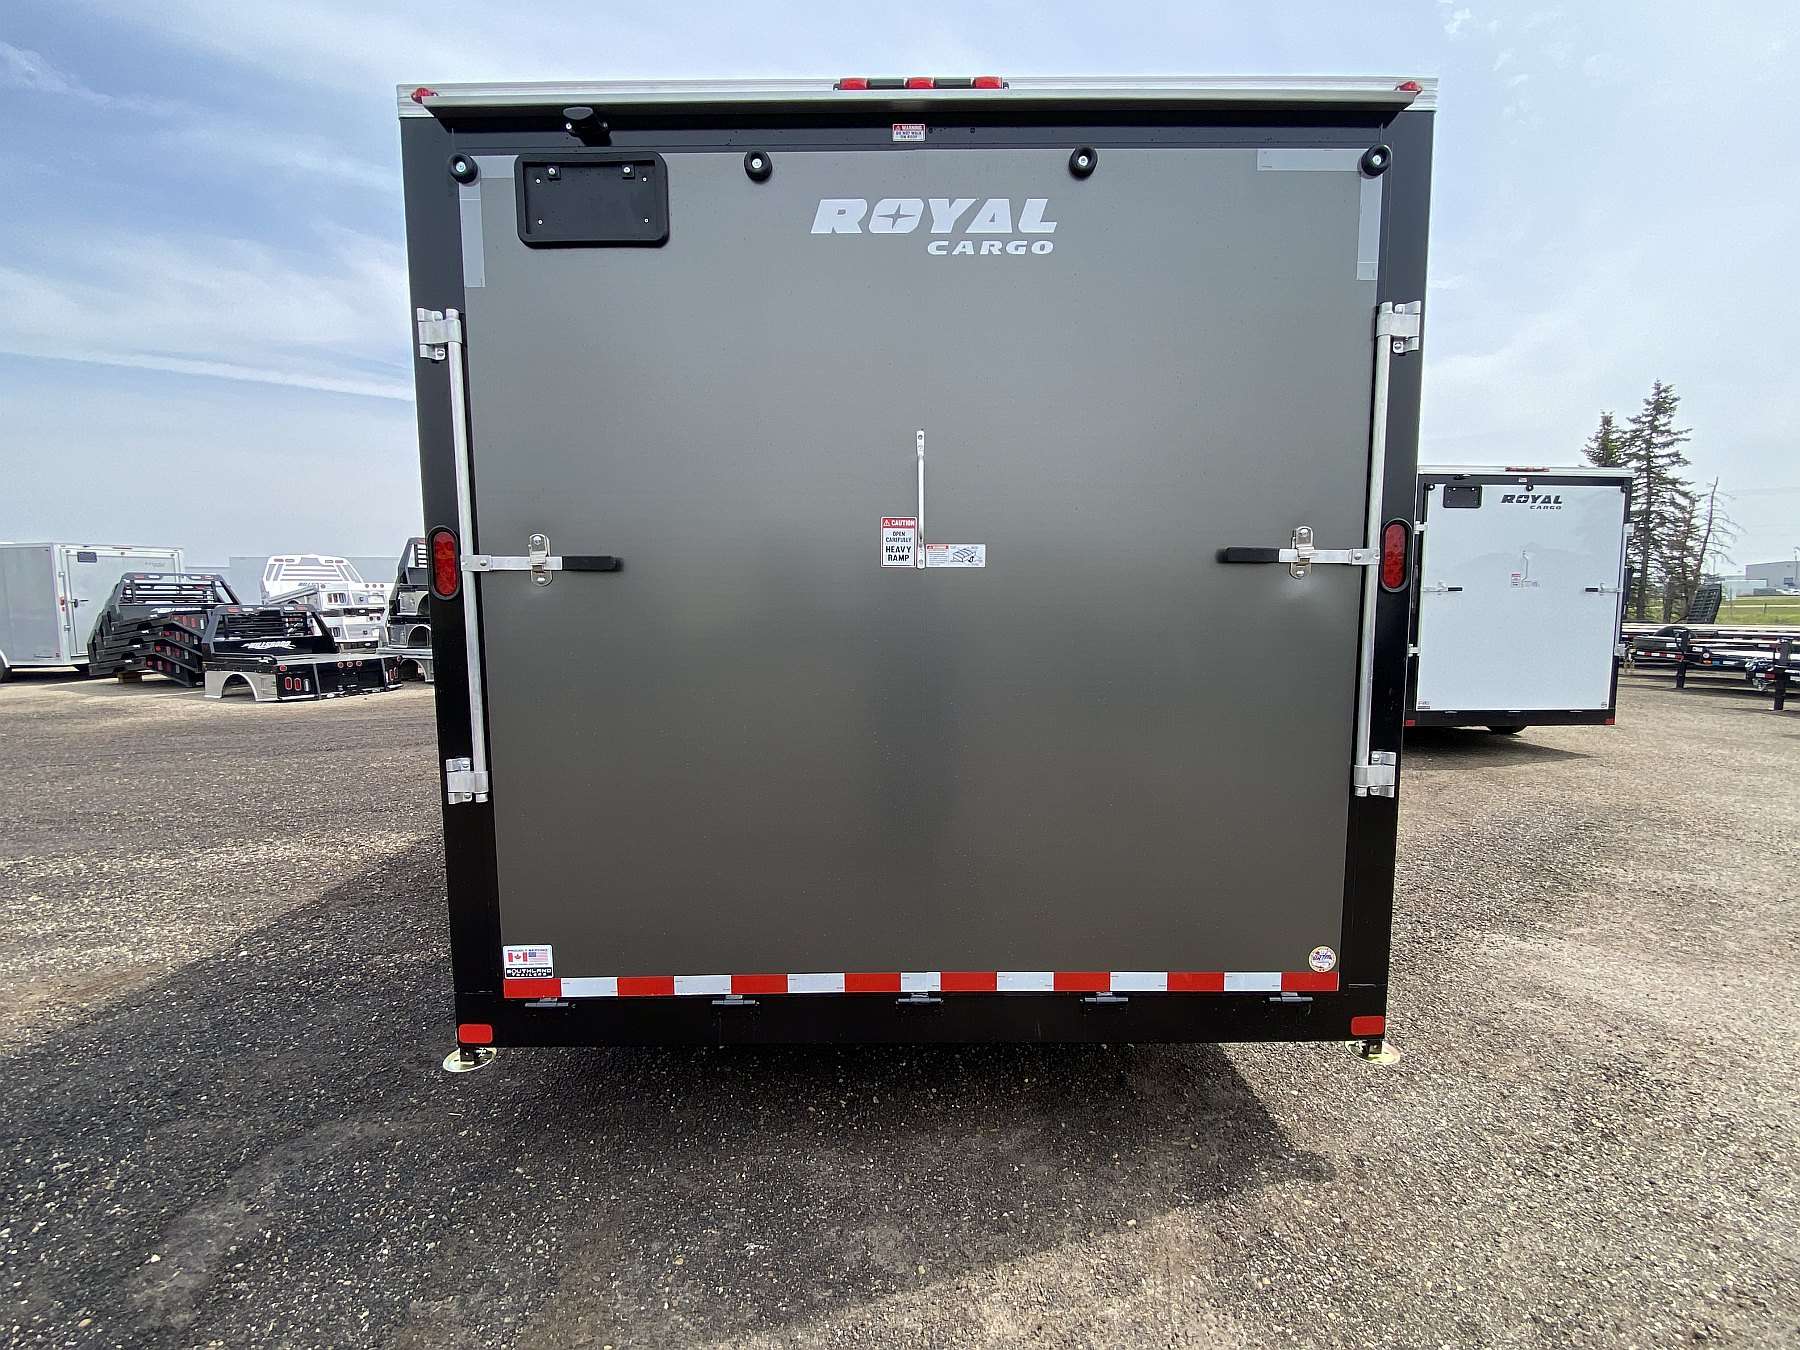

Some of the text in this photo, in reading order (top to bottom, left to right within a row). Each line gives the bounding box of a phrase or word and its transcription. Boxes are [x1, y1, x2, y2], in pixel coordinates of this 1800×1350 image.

[810, 198, 1058, 234] ROYAL
[927, 240, 1054, 255] CARGO
[1501, 494, 1563, 504] ROYAL
[891, 519, 915, 527] CAUTION
[885, 545, 912, 553] HEAVY
[888, 554, 910, 562] RAMP
